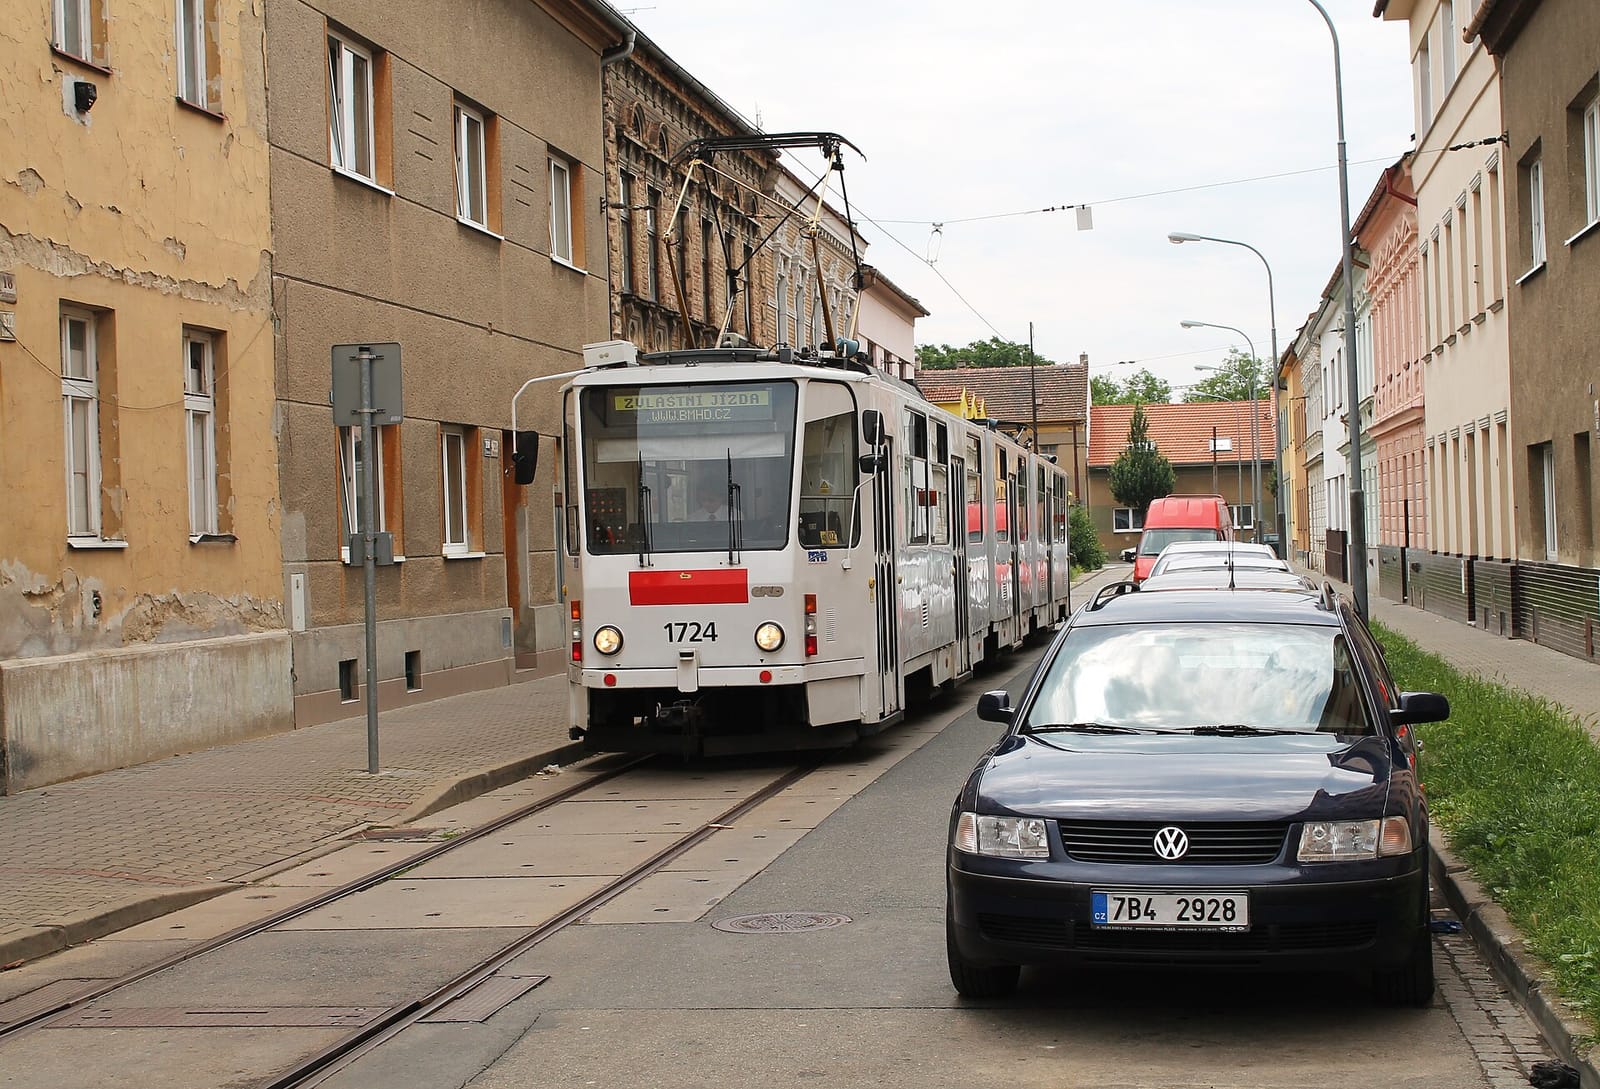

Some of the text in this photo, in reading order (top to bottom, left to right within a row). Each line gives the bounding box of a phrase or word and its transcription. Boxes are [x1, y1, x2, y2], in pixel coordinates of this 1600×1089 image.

[664, 621, 719, 643] 1724
[1154, 826, 1189, 860] VW
[1094, 912, 1106, 920] CZ
[1112, 896, 1236, 922] 7B4 2928
